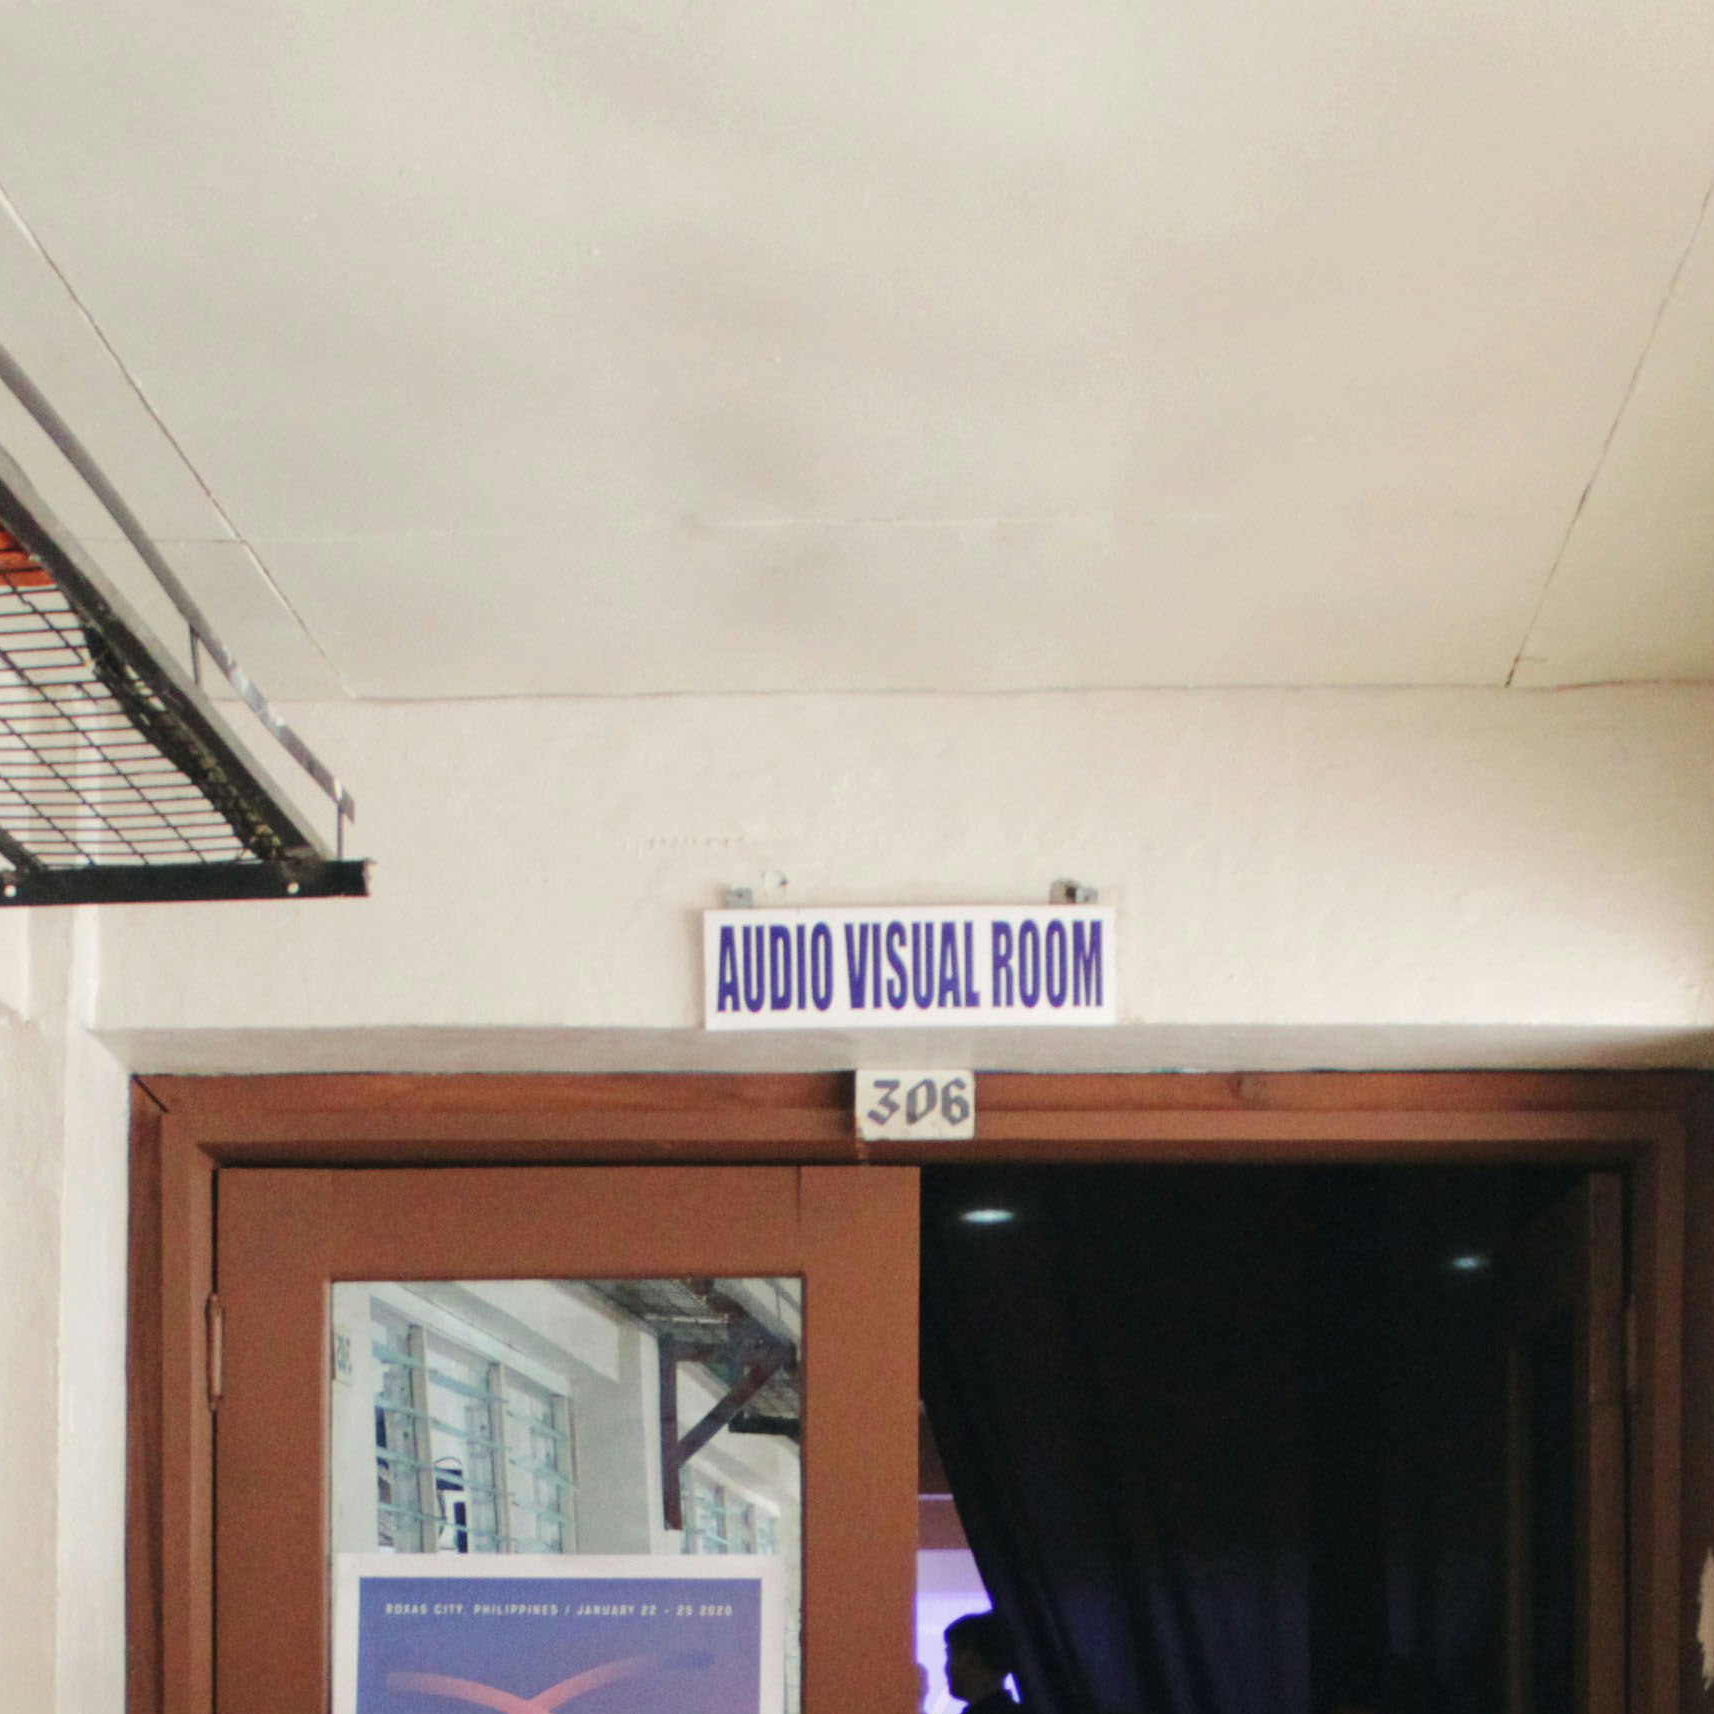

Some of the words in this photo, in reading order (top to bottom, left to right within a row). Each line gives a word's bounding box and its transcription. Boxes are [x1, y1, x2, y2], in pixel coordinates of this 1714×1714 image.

[717, 922, 833, 1013] AUDIO
[844, 919, 980, 1010] VISUAL
[992, 919, 1103, 1009] ROOM
[867, 1077, 970, 1125] 306
[386, 1603, 428, 1616] ROXAS
[473, 1603, 559, 1616] PHILIPPINES
[576, 1604, 636, 1617] JANUARY
[641, 1604, 657, 1616] 22
[699, 1604, 733, 1616] 2020
